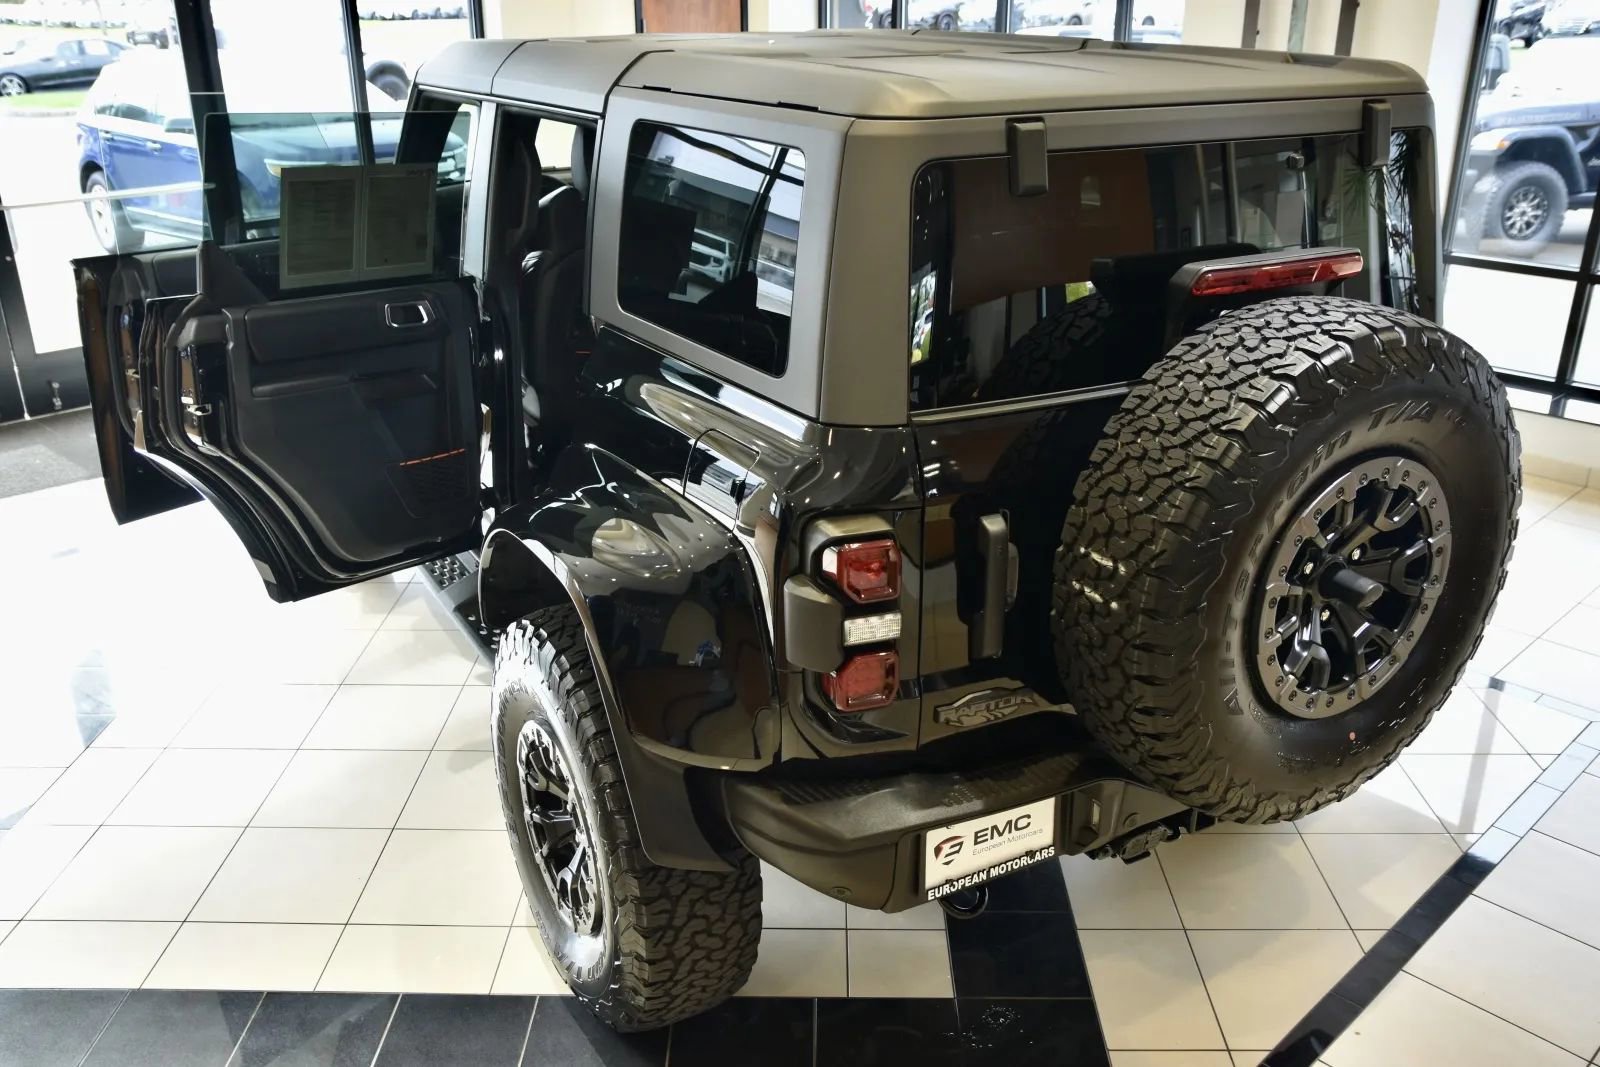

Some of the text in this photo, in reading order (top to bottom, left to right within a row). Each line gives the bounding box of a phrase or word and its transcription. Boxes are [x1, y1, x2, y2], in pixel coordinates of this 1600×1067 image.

[972, 828, 1043, 856] European Motorcars
[973, 813, 1032, 846] EMC
[927, 870, 987, 900] EUROPEAN
